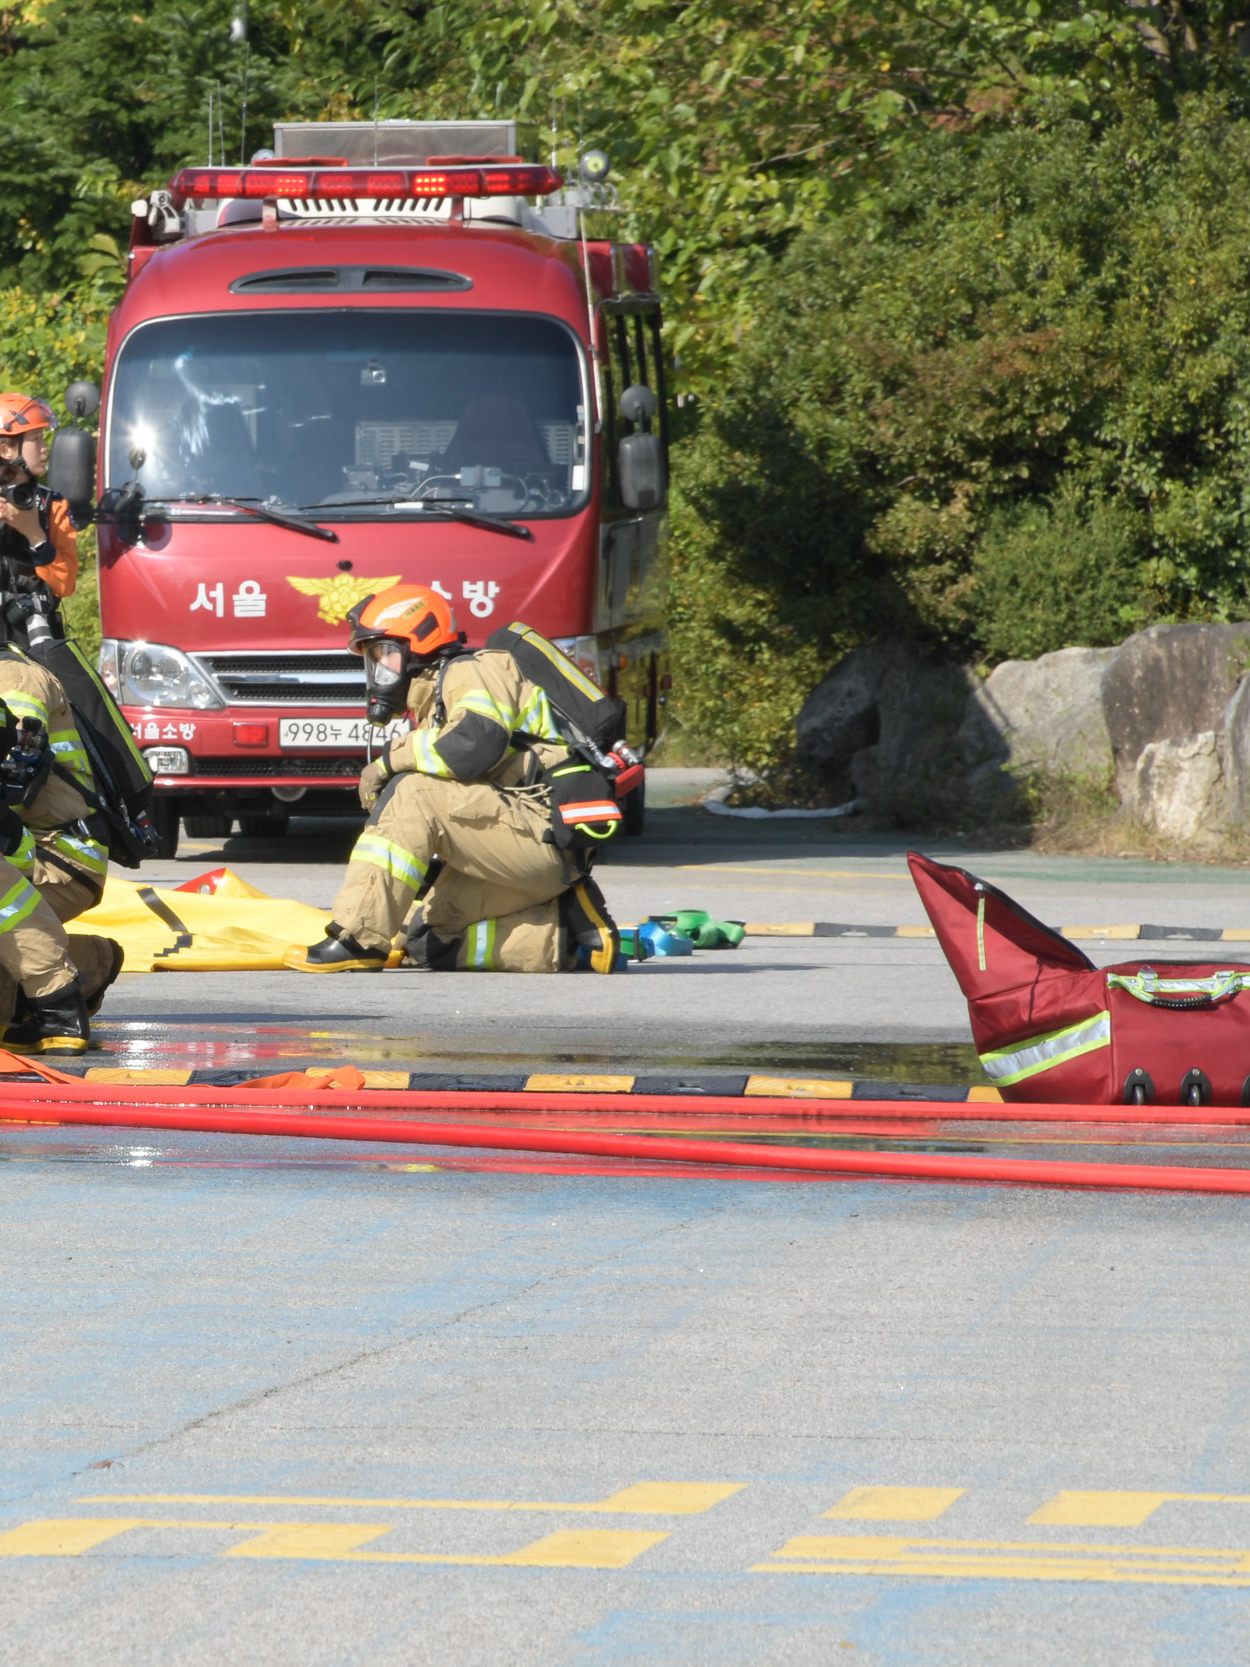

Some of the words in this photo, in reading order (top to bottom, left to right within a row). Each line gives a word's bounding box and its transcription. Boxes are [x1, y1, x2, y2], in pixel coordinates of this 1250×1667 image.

[190, 580, 268, 618] 서울
[131, 722, 196, 741] 서울소방
[288, 723, 342, 742] 998누
